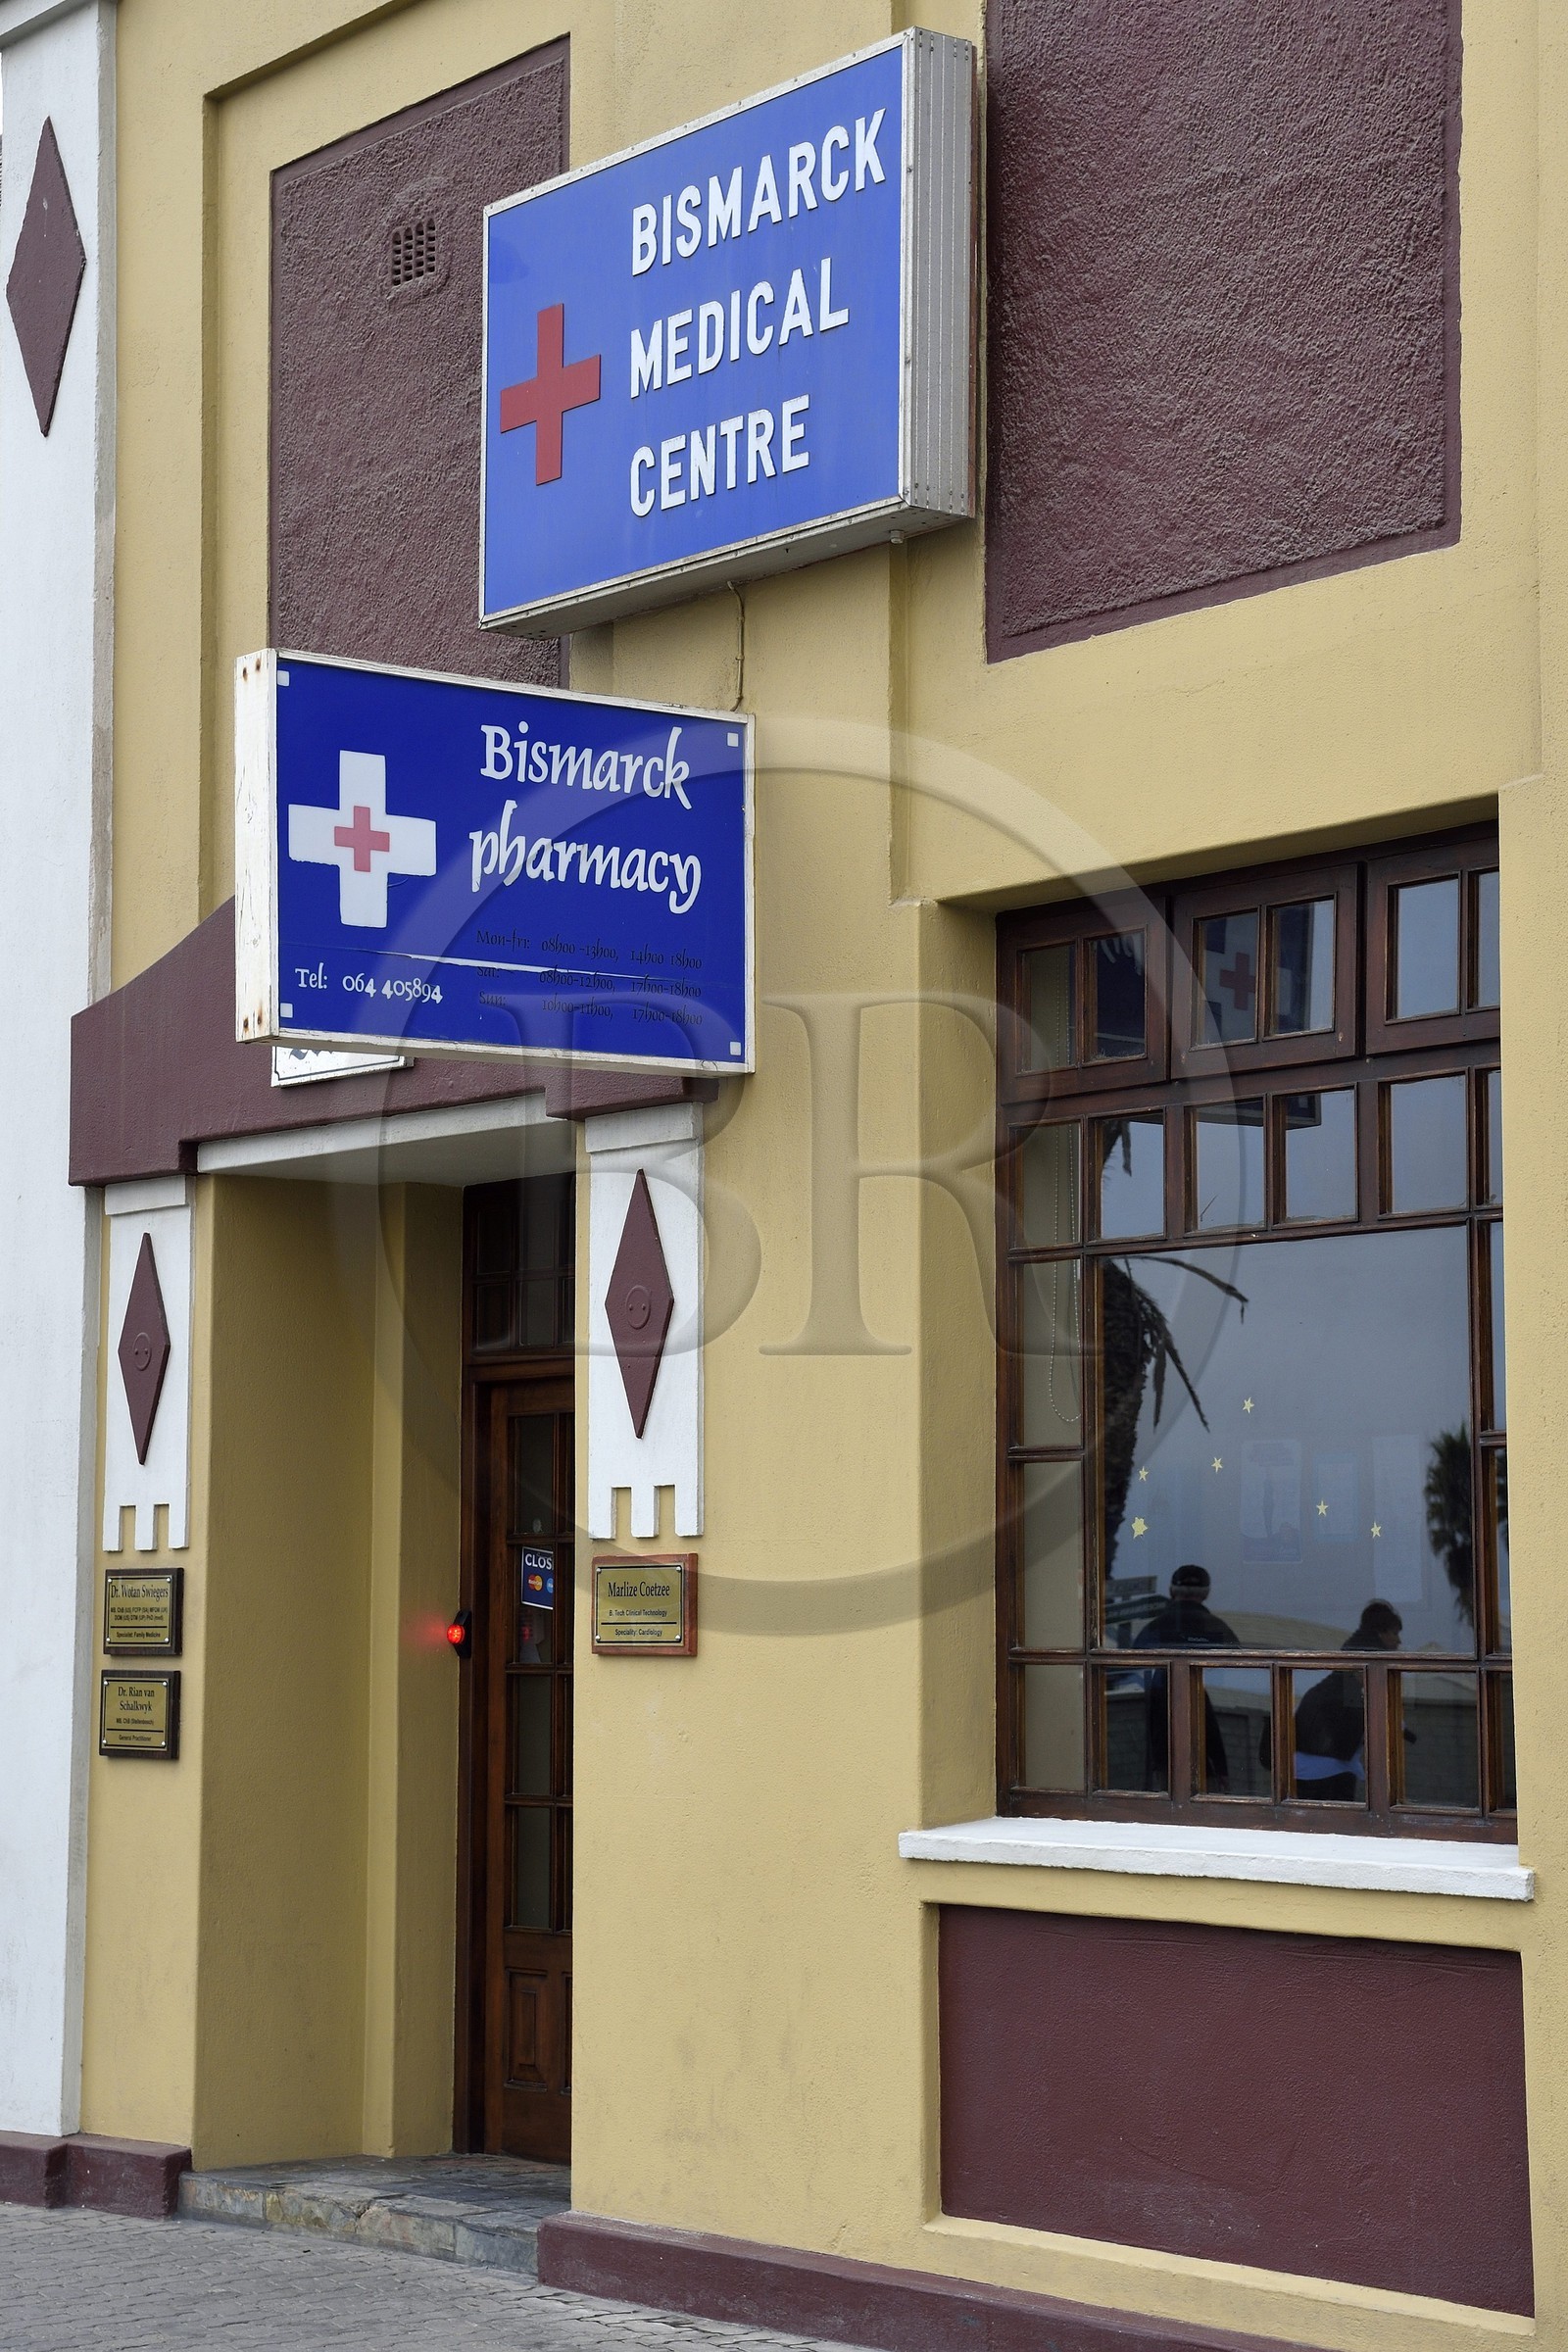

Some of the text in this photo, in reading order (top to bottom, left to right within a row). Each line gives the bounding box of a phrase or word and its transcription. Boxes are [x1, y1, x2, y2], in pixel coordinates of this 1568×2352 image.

[632, 108, 886, 275] BISMARCK
[630, 257, 850, 399] MEDICAL
[630, 394, 810, 516] CENTRE
[479, 720, 692, 809] Bismarck
[468, 800, 702, 913] pharmacy
[541, 934, 575, 955] 08h00
[294, 966, 444, 1004] Tel: 064 405894
[631, 975, 702, 998] 17h00-18h00
[479, 991, 508, 1006] Sun:
[111, 1585, 120, 1598] Dr.
[608, 1581, 670, 1597] Marlize Coetzee
[118, 1687, 127, 1696] Dr.
[129, 1687, 143, 1696] Rian
[120, 1700, 153, 1714] Schalkwyk
